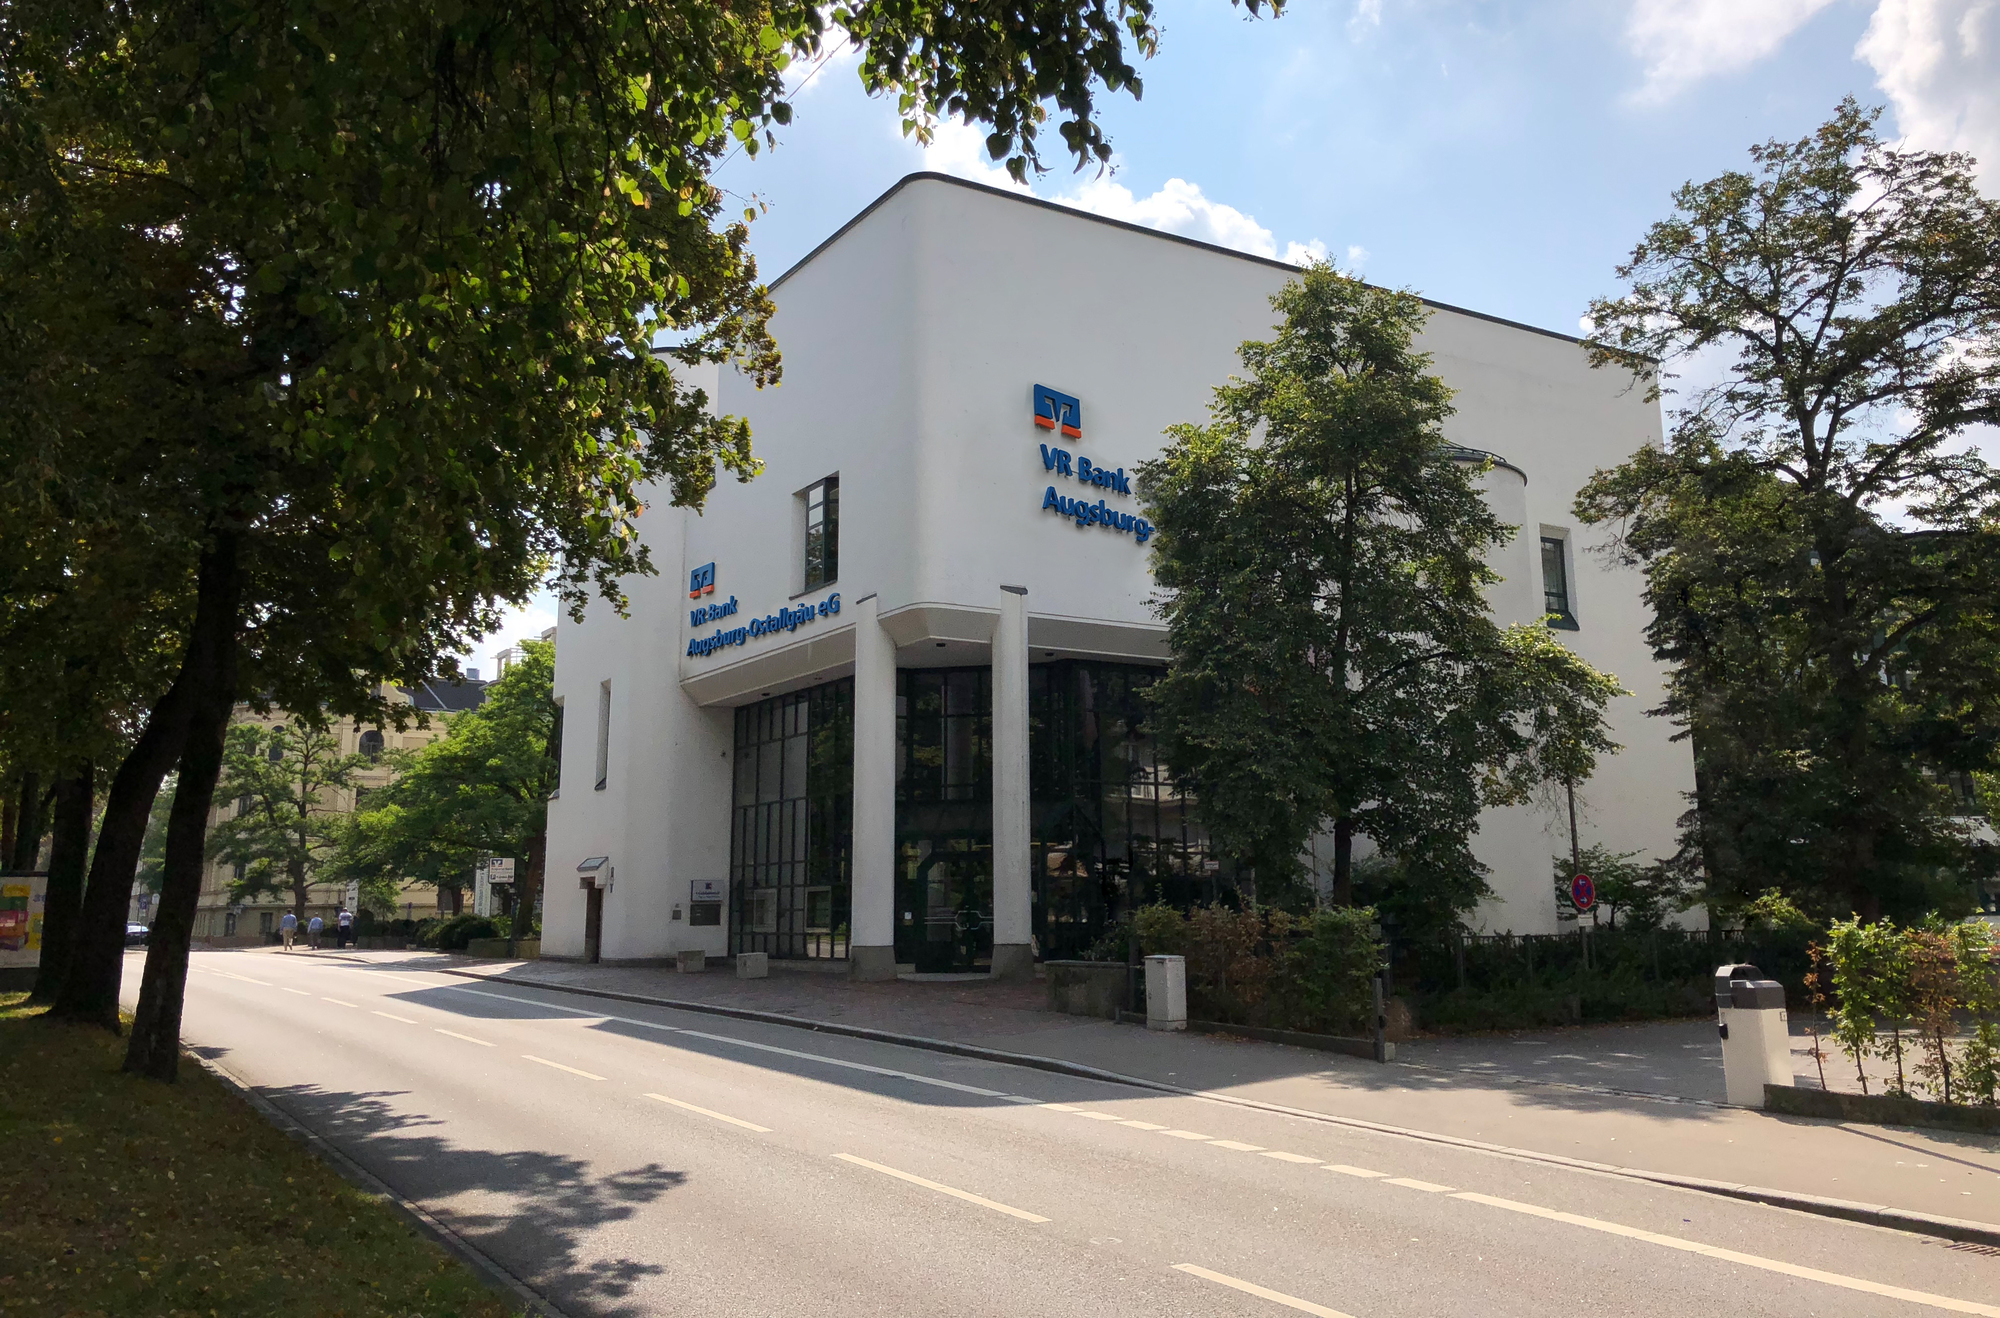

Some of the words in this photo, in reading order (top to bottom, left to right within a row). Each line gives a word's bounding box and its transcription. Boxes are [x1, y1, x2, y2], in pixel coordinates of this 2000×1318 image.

[1040, 443, 1073, 476] VR
[1078, 456, 1131, 495] Bank
[1042, 486, 1155, 542] Augsburg-
[686, 603, 815, 657] Augsburg-Ostallgäu
[817, 592, 841, 617] eG
[690, 607, 706, 628] VR
[707, 595, 738, 622] Bank
